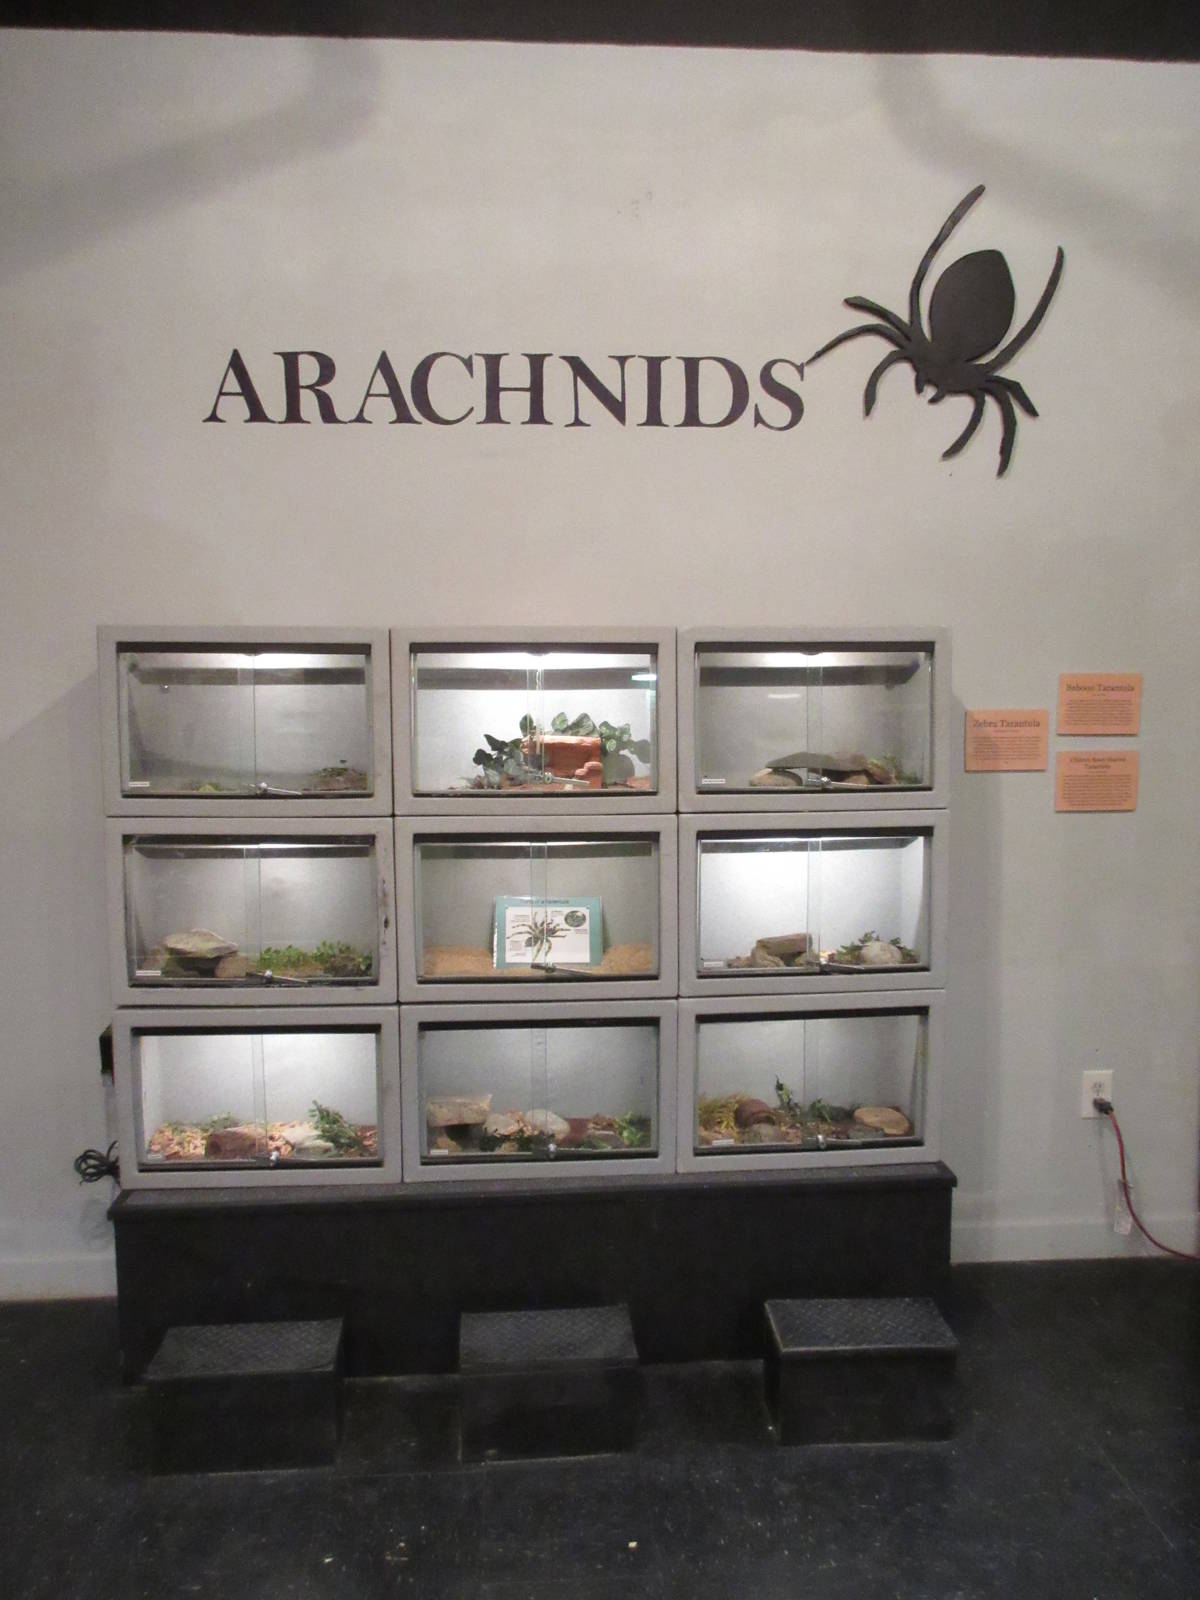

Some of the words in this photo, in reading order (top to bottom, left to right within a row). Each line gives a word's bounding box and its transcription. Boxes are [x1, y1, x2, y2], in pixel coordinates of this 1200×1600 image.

[203, 348, 806, 431] ARACHNIDS
[972, 719, 998, 728] Zebra
[1000, 719, 1041, 728] Tarantula
